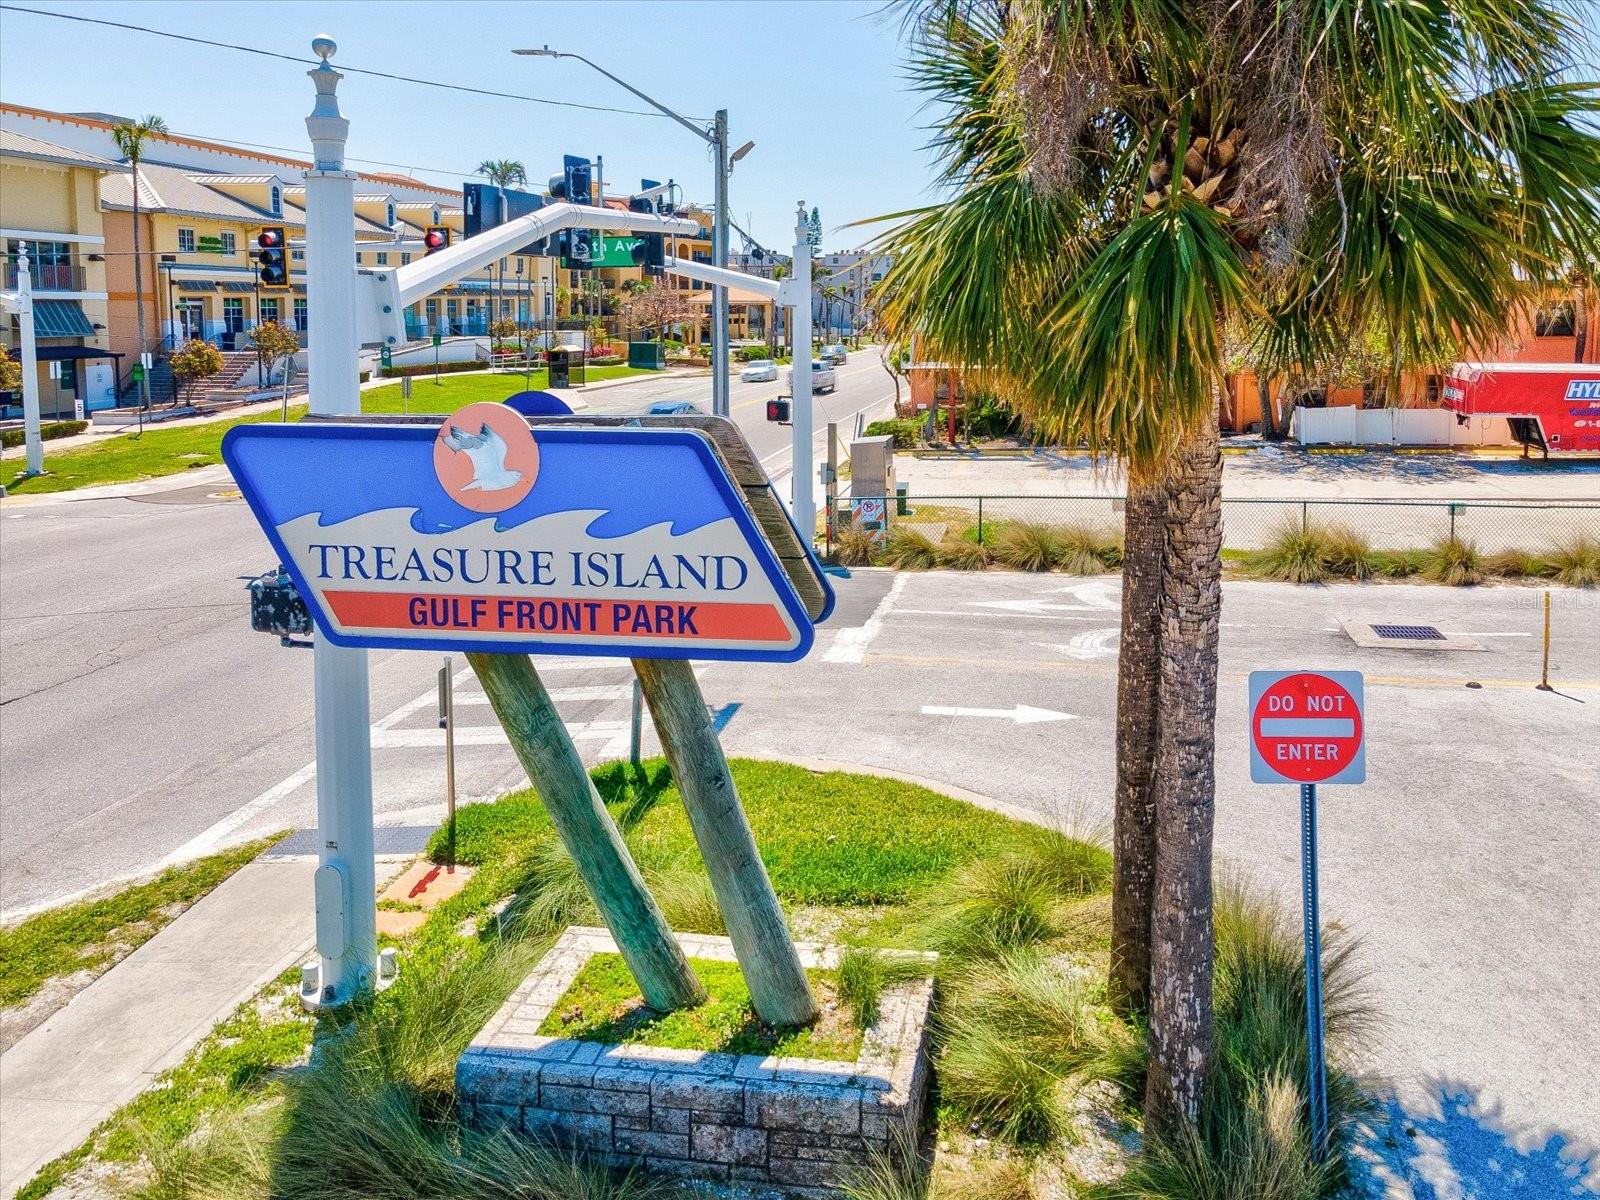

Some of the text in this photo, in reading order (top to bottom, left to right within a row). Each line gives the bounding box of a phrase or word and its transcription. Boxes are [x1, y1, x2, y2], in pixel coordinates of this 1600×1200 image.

[591, 239, 635, 252] th Av
[308, 544, 748, 591] TREASURE ISLAND
[408, 596, 699, 635] GULF FRONT PARK
[1268, 695, 1346, 712] DO NOT
[1276, 743, 1339, 760] ENTER
